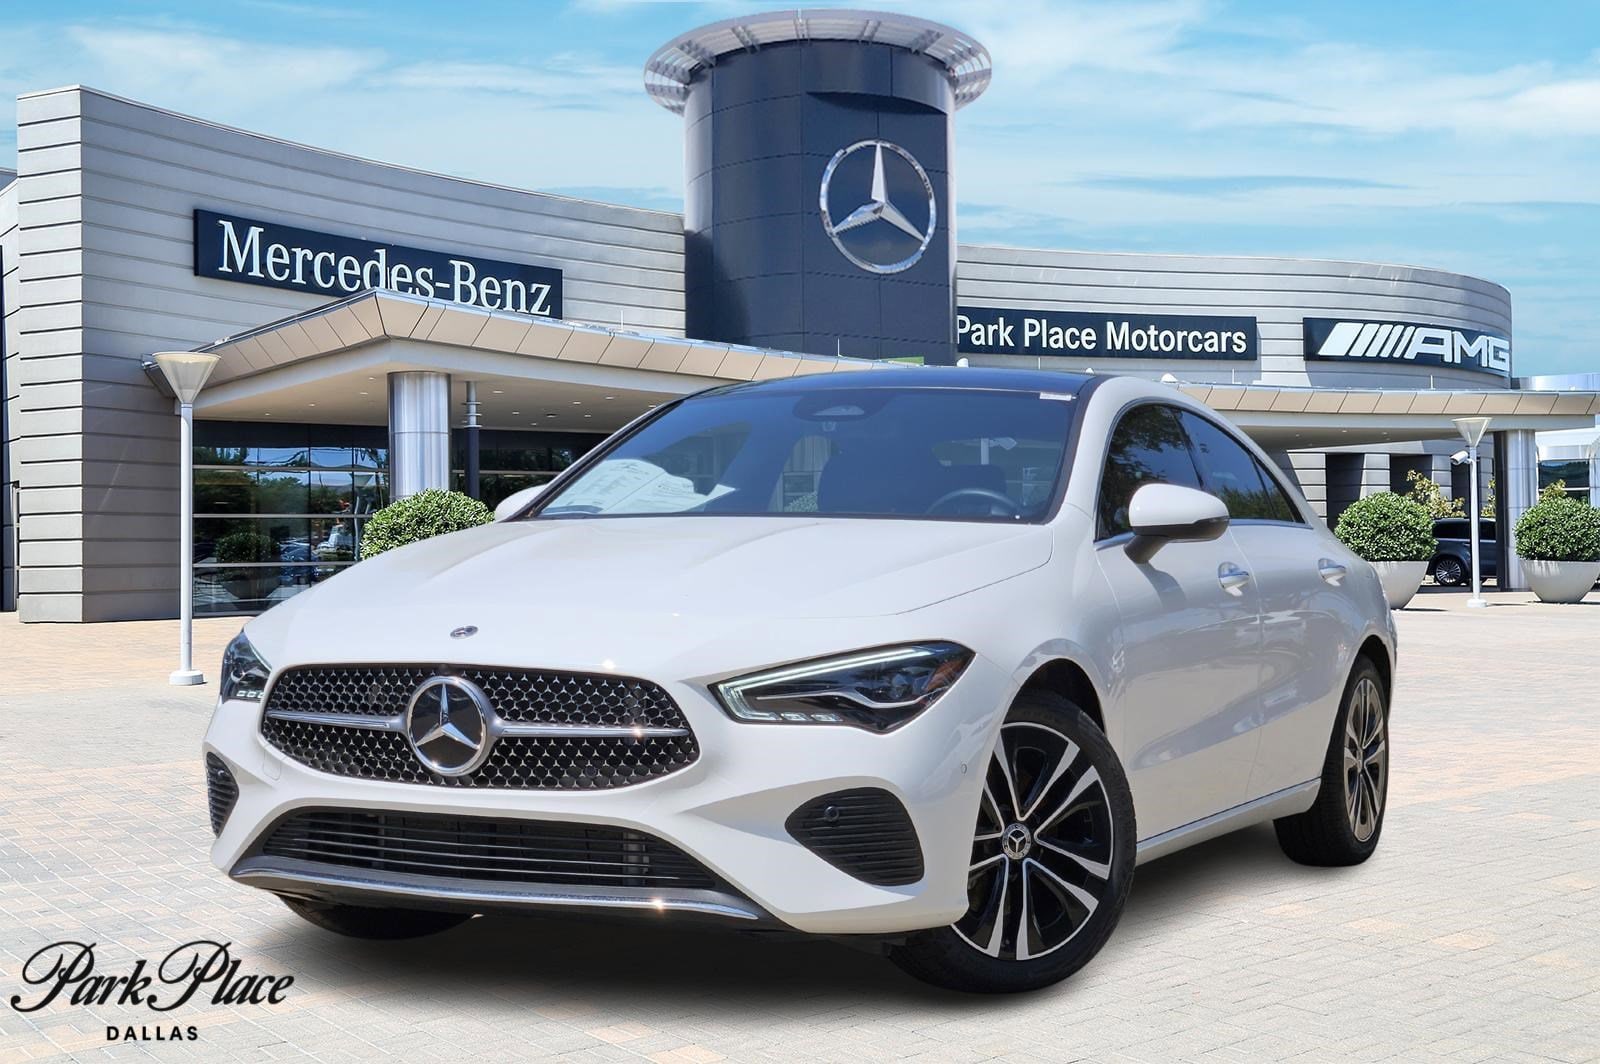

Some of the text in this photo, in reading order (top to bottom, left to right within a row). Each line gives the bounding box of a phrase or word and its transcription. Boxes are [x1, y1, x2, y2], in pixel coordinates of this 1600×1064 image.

[218, 220, 551, 316] Mercedes-Benz
[957, 315, 1247, 353] Park Place Motorcars
